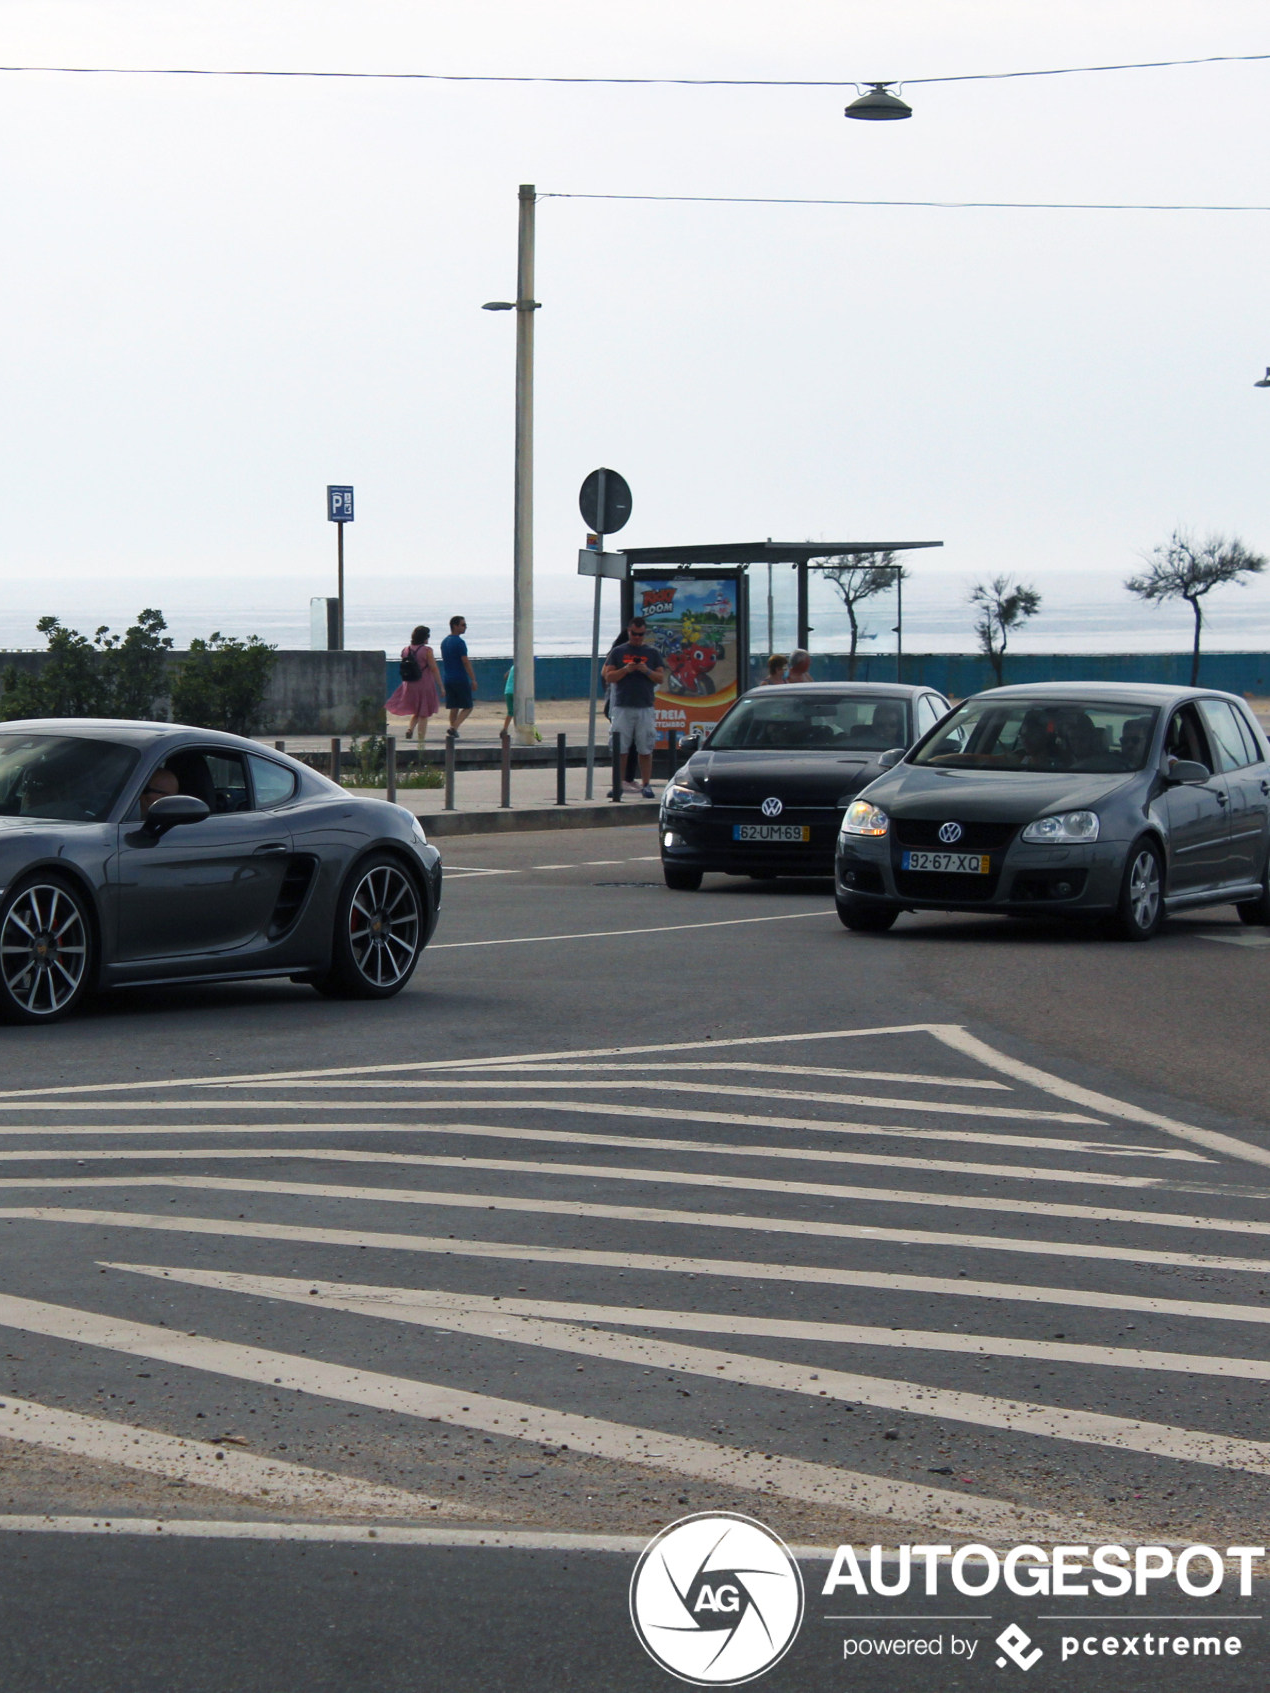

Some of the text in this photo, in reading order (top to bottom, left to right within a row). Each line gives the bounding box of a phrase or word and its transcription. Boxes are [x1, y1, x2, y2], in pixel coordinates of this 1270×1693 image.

[332, 495, 342, 514] P
[642, 603, 673, 617] ZOOM
[762, 797, 782, 817] VW
[740, 826, 801, 839] 62-UM-69
[939, 822, 961, 843] VW
[910, 853, 979, 871] 92-67-XQ
